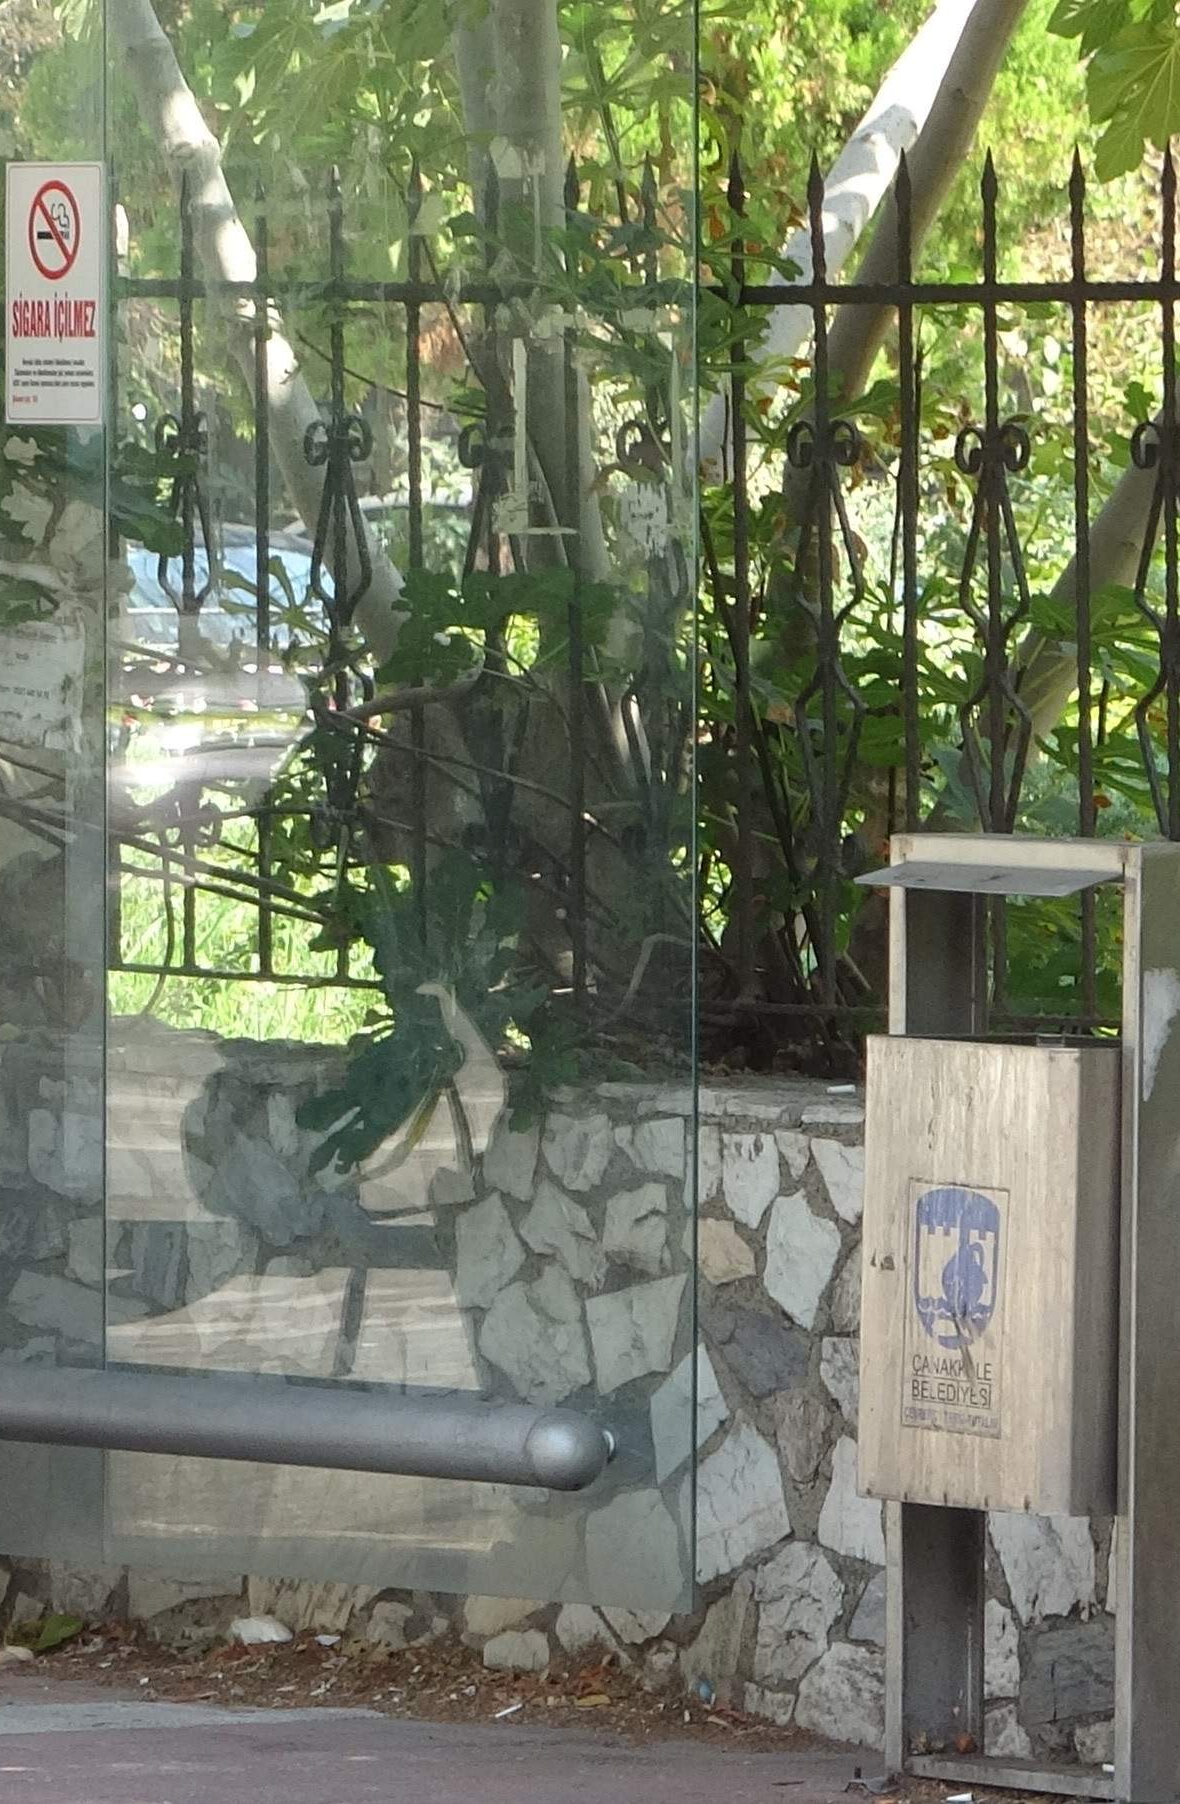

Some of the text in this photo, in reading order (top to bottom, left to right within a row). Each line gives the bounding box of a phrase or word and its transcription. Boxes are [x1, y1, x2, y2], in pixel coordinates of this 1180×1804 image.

[12, 291, 96, 343] SİGARA İÇİLMEZ
[912, 1354, 992, 1382] ÇANAKKLE
